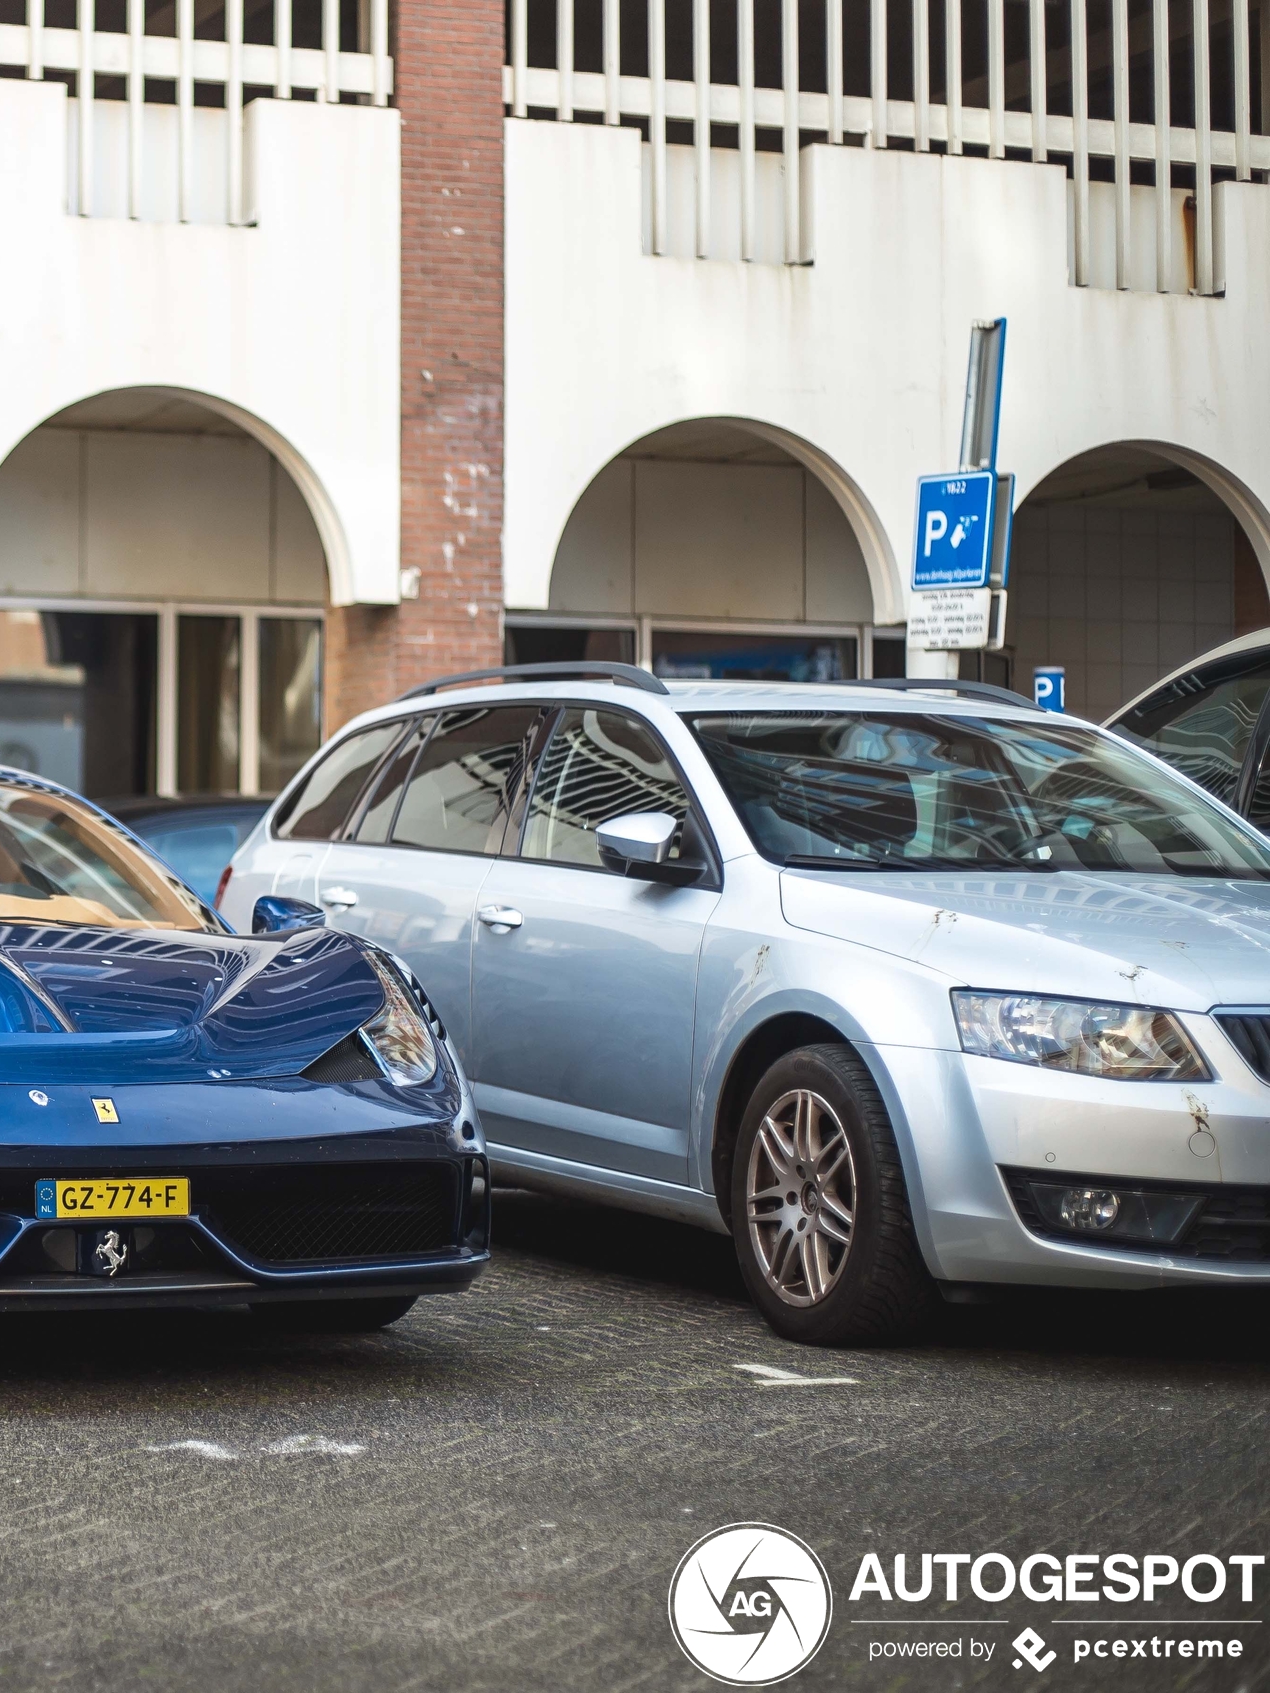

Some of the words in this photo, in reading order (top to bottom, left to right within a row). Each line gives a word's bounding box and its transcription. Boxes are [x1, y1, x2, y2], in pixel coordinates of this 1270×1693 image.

[924, 509, 948, 558] P
[1034, 676, 1054, 706] P
[41, 1205, 53, 1213] NL
[61, 1185, 178, 1211] GZ-774-F
